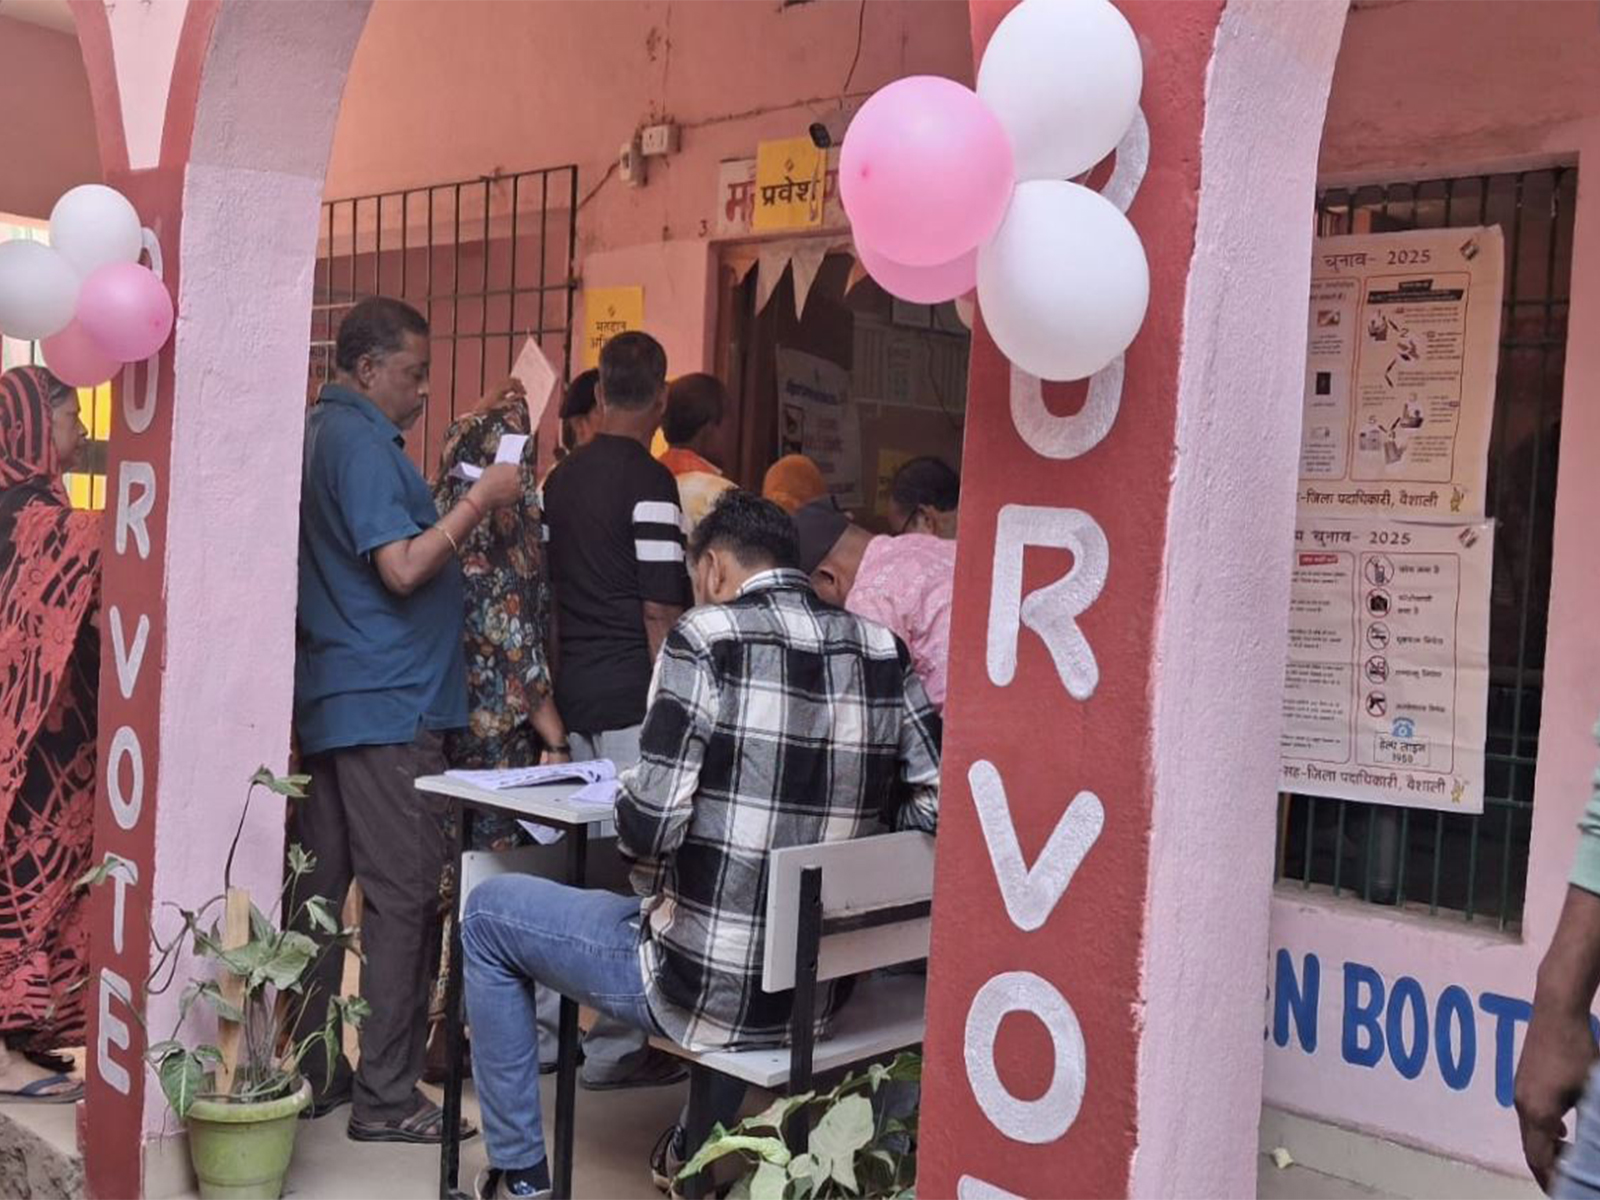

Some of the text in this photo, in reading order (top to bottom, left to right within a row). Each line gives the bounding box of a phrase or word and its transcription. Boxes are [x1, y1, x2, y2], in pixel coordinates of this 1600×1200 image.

[760, 176, 820, 206] प्रवेश
[1387, 249, 1431, 265] 2025
[1399, 490, 1438, 507] वैशाली
[1369, 531, 1412, 545] 2025
[1407, 772, 1446, 794] वैशाली
[97, 605, 150, 1095] VOTE
[956, 759, 1104, 1200] VO
